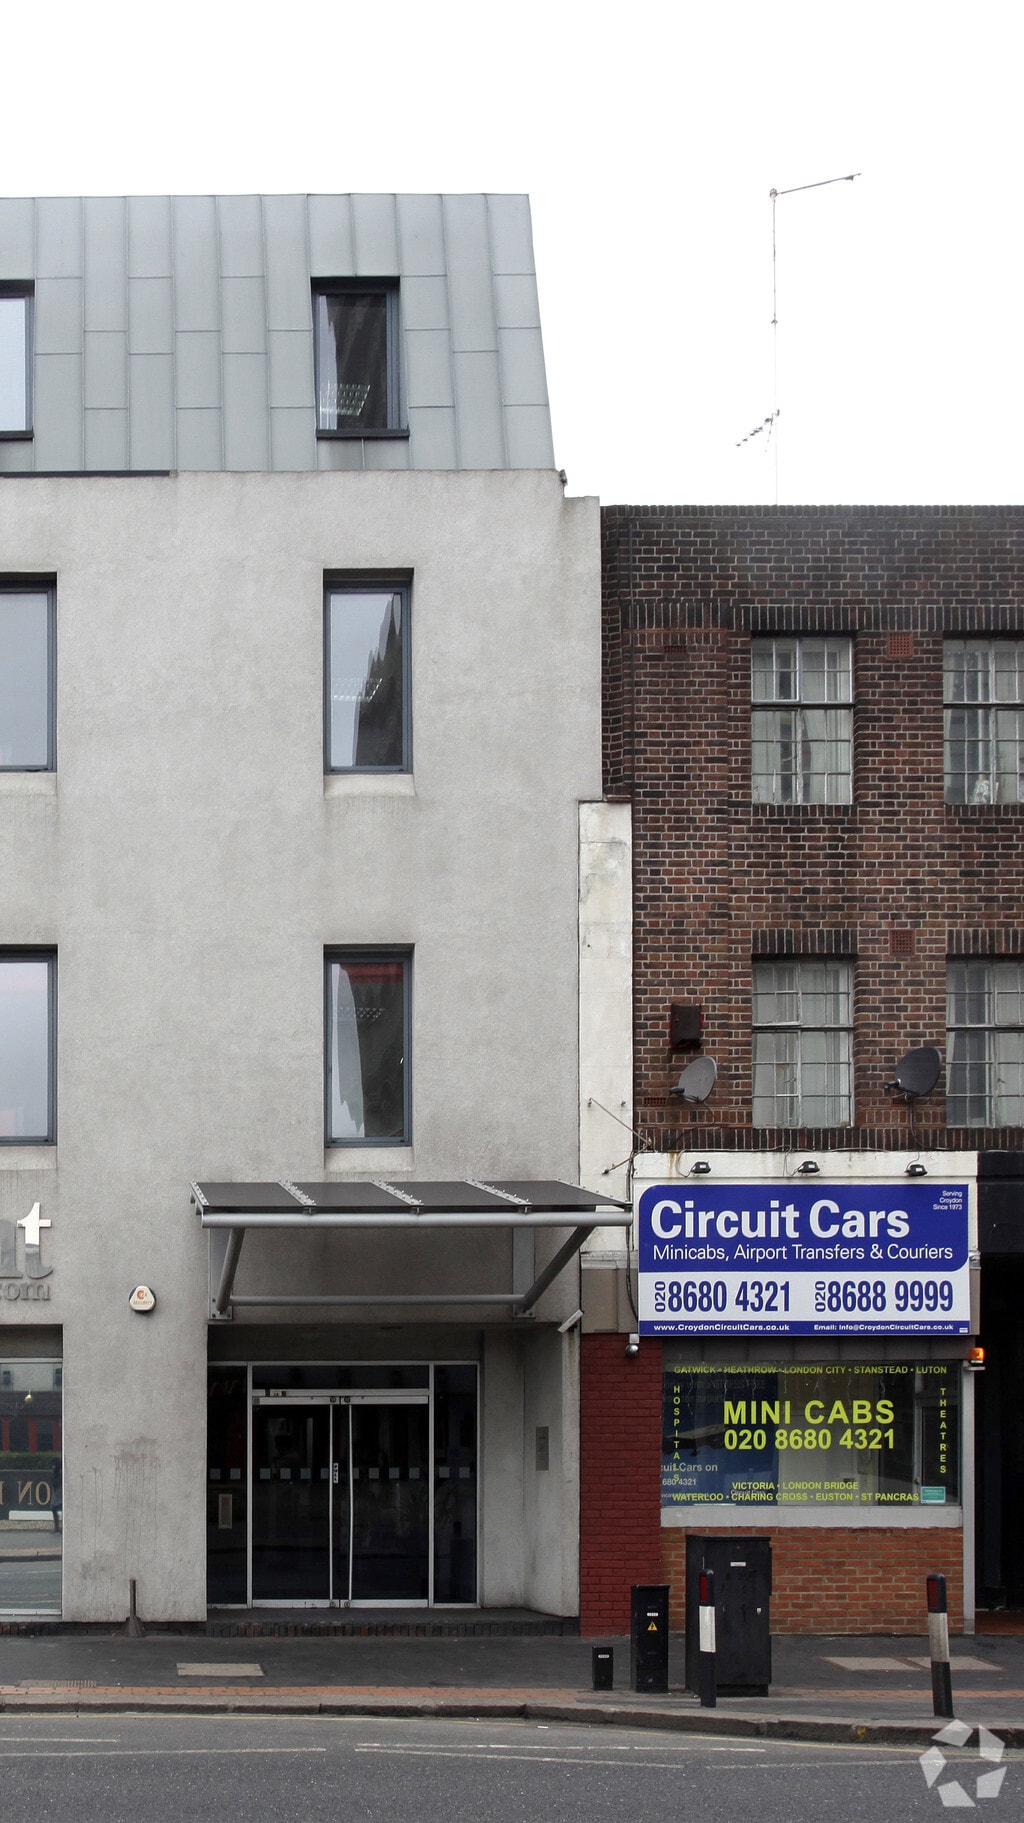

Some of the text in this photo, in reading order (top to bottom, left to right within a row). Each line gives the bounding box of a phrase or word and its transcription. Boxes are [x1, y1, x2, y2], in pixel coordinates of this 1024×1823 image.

[942, 1190, 963, 1198] Serving
[651, 1199, 910, 1239] Circuit Cars
[653, 1243, 954, 1263] Minicabs, Airport Transfers & Couriers
[655, 1280, 790, 1312] 020 8680 4321
[814, 1280, 954, 1312] 020 8688 9999
[814, 1323, 837, 1331] Email:
[673, 1366, 947, 1374] GATWICK HEATHROW LONDON CITY STANSTEAD LUTON
[723, 1400, 895, 1425] MINI CABS
[939, 1388, 947, 1473] THEATRES
[724, 1428, 894, 1450] 020 8680 4321
[679, 1462, 702, 1472] Cars
[705, 1464, 718, 1472] on
[678, 1478, 696, 1486] 4321
[732, 1481, 859, 1490] VICTORIA LONDON BRIDGE
[672, 1493, 724, 1501] WATERLOO
[731, 1493, 774, 1501] CHARING
[776, 1493, 808, 1501] CROSS
[816, 1493, 853, 1501] EUSTON
[861, 1493, 873, 1501] ST
[875, 1493, 919, 1501] PANCRAS
